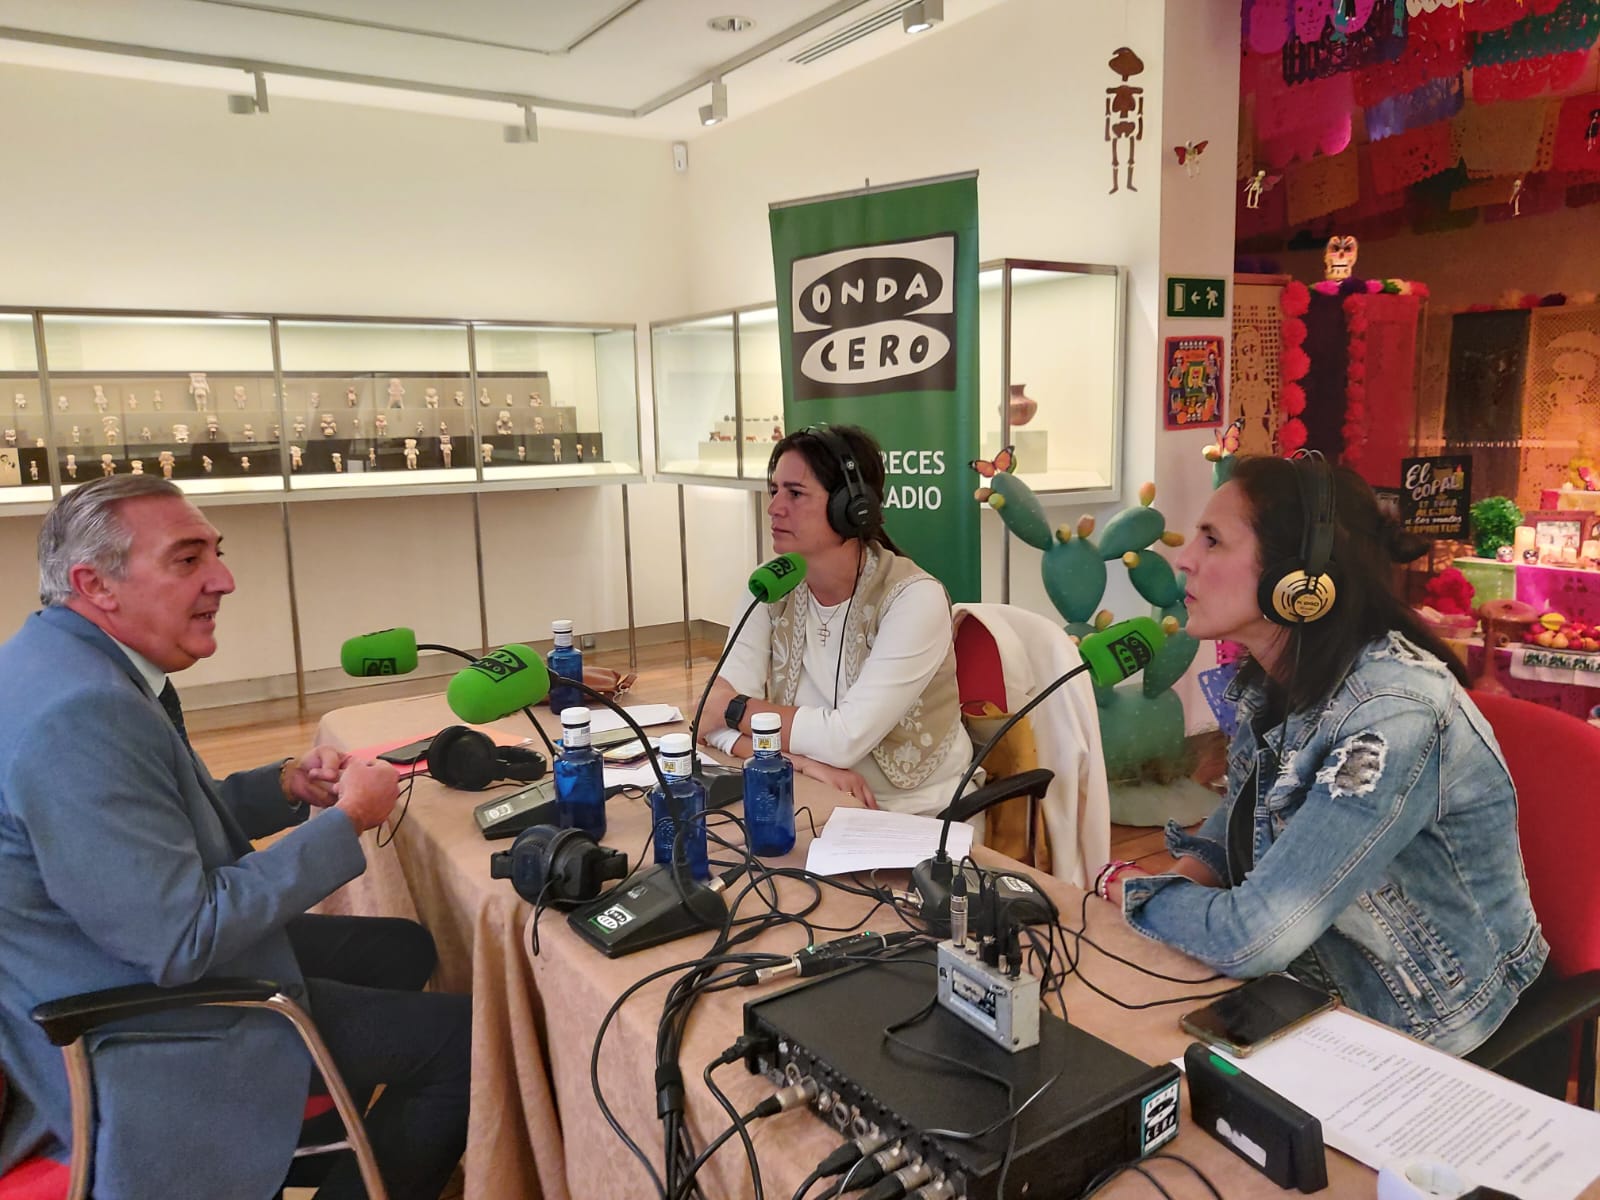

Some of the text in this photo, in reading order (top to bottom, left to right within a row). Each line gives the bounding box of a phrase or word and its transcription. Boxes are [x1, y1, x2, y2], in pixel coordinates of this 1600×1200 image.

[811, 272, 929, 314] ONDA
[820, 334, 930, 372] CERO
[1405, 462, 1431, 490] El
[1411, 475, 1460, 501] COPAL
[881, 485, 942, 510] ADIO
